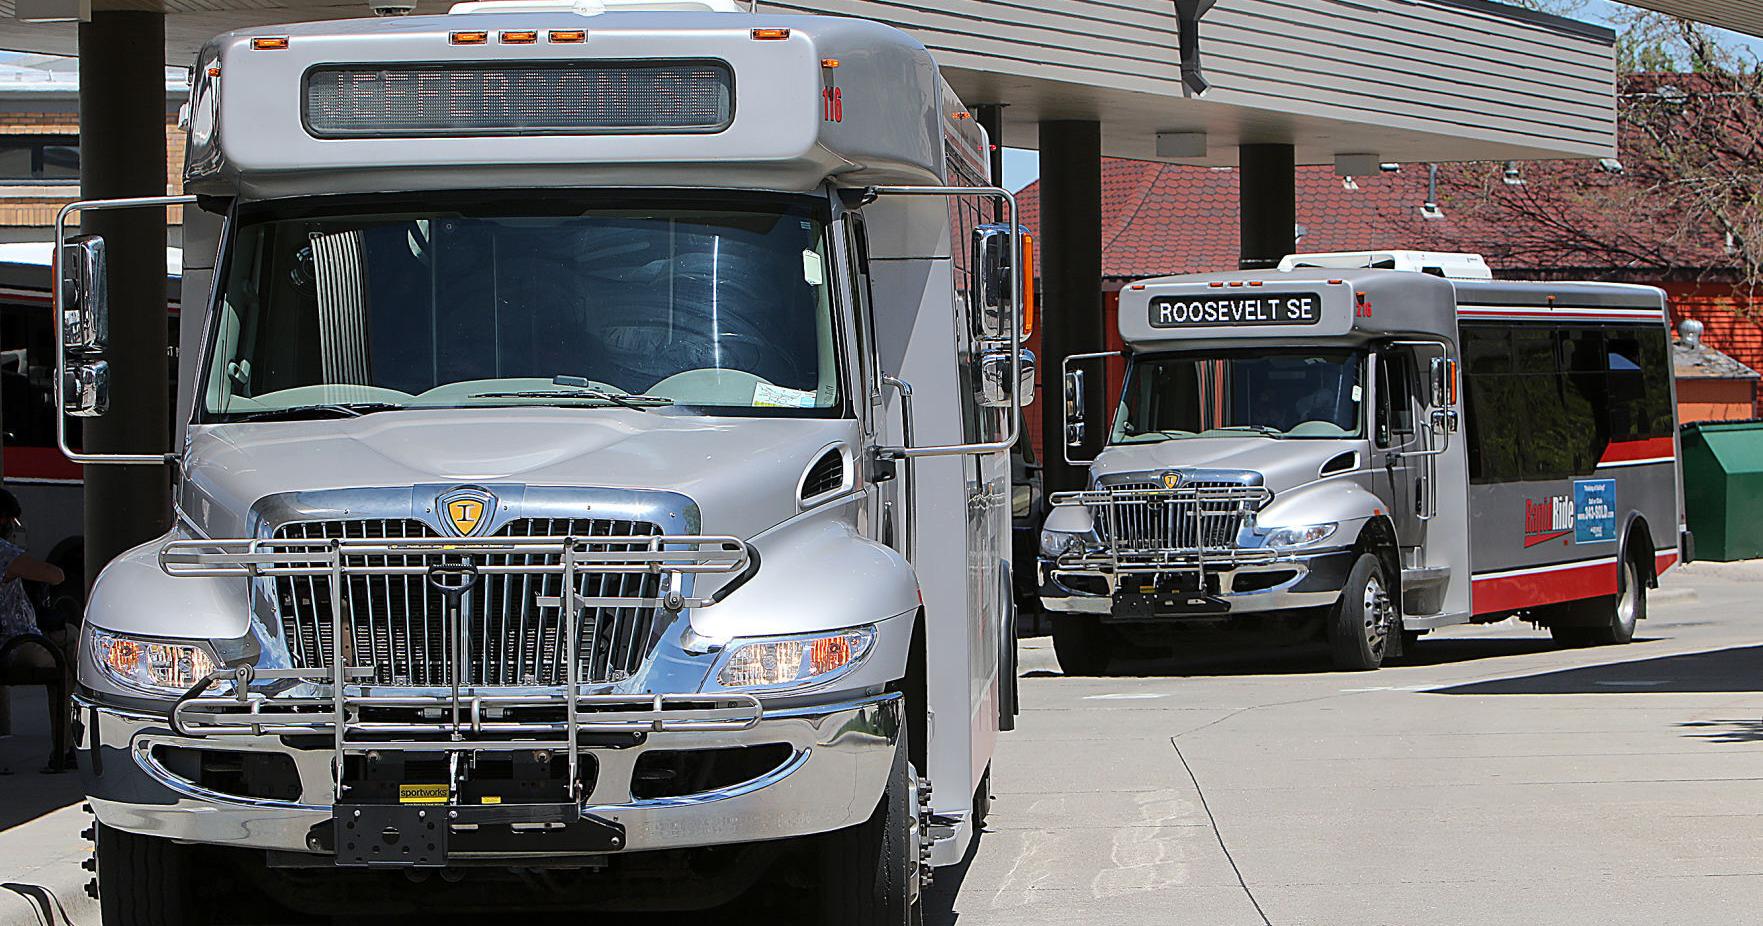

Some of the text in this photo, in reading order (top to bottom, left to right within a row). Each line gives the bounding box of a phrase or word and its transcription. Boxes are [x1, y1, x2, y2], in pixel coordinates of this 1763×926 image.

[321, 71, 716, 118] JEFFERSON SE
[823, 86, 843, 122] 116
[1160, 298, 1312, 322] ROOSEVELT SE
[1356, 302, 1372, 317] 216
[401, 788, 447, 798] sportworks
